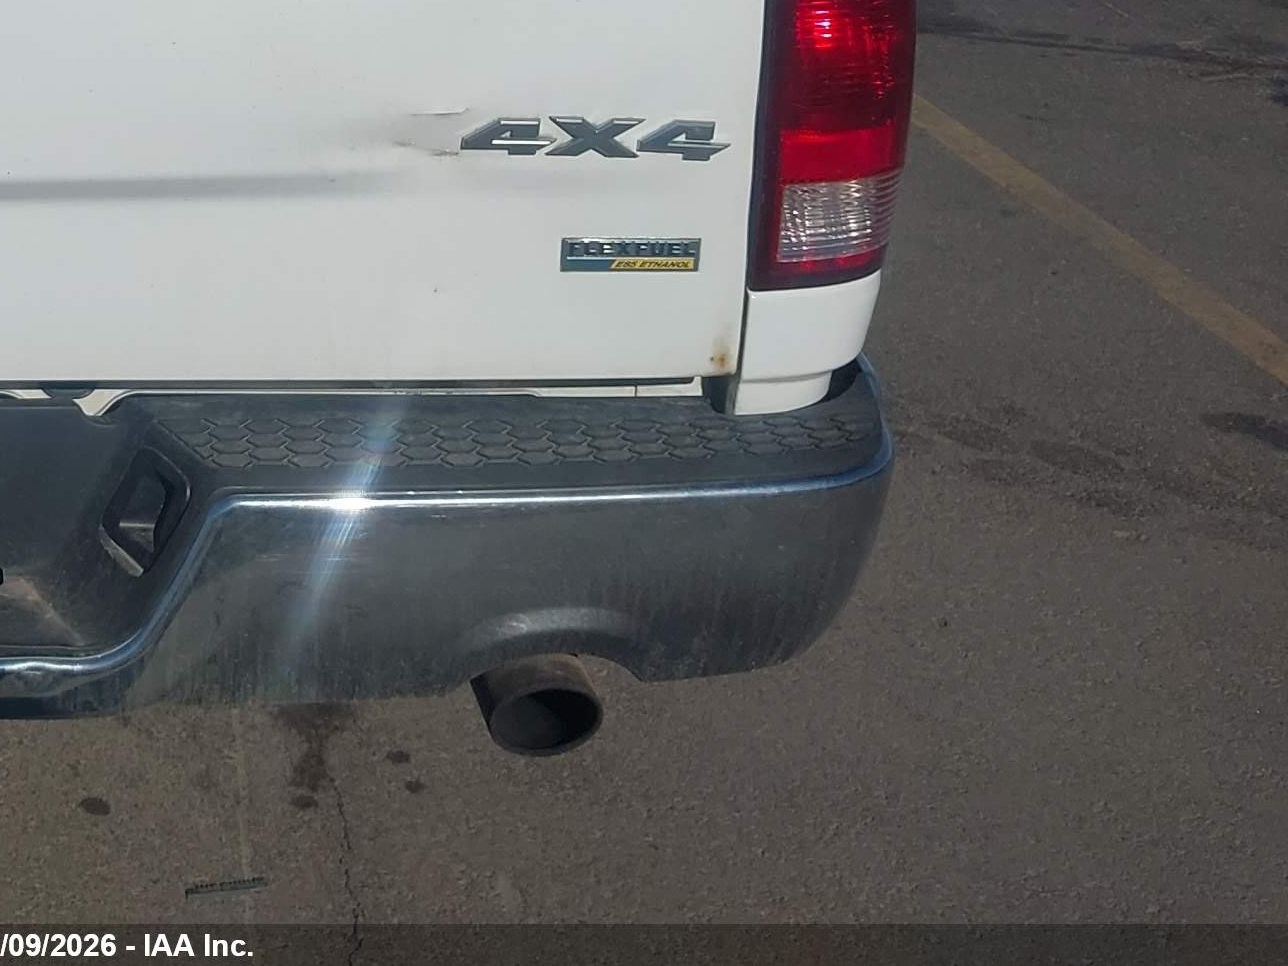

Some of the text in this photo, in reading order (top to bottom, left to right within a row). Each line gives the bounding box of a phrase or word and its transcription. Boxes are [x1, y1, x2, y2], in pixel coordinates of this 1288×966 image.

[460, 115, 731, 161] 4X4
[614, 260, 691, 268] E85 ETHANOL
